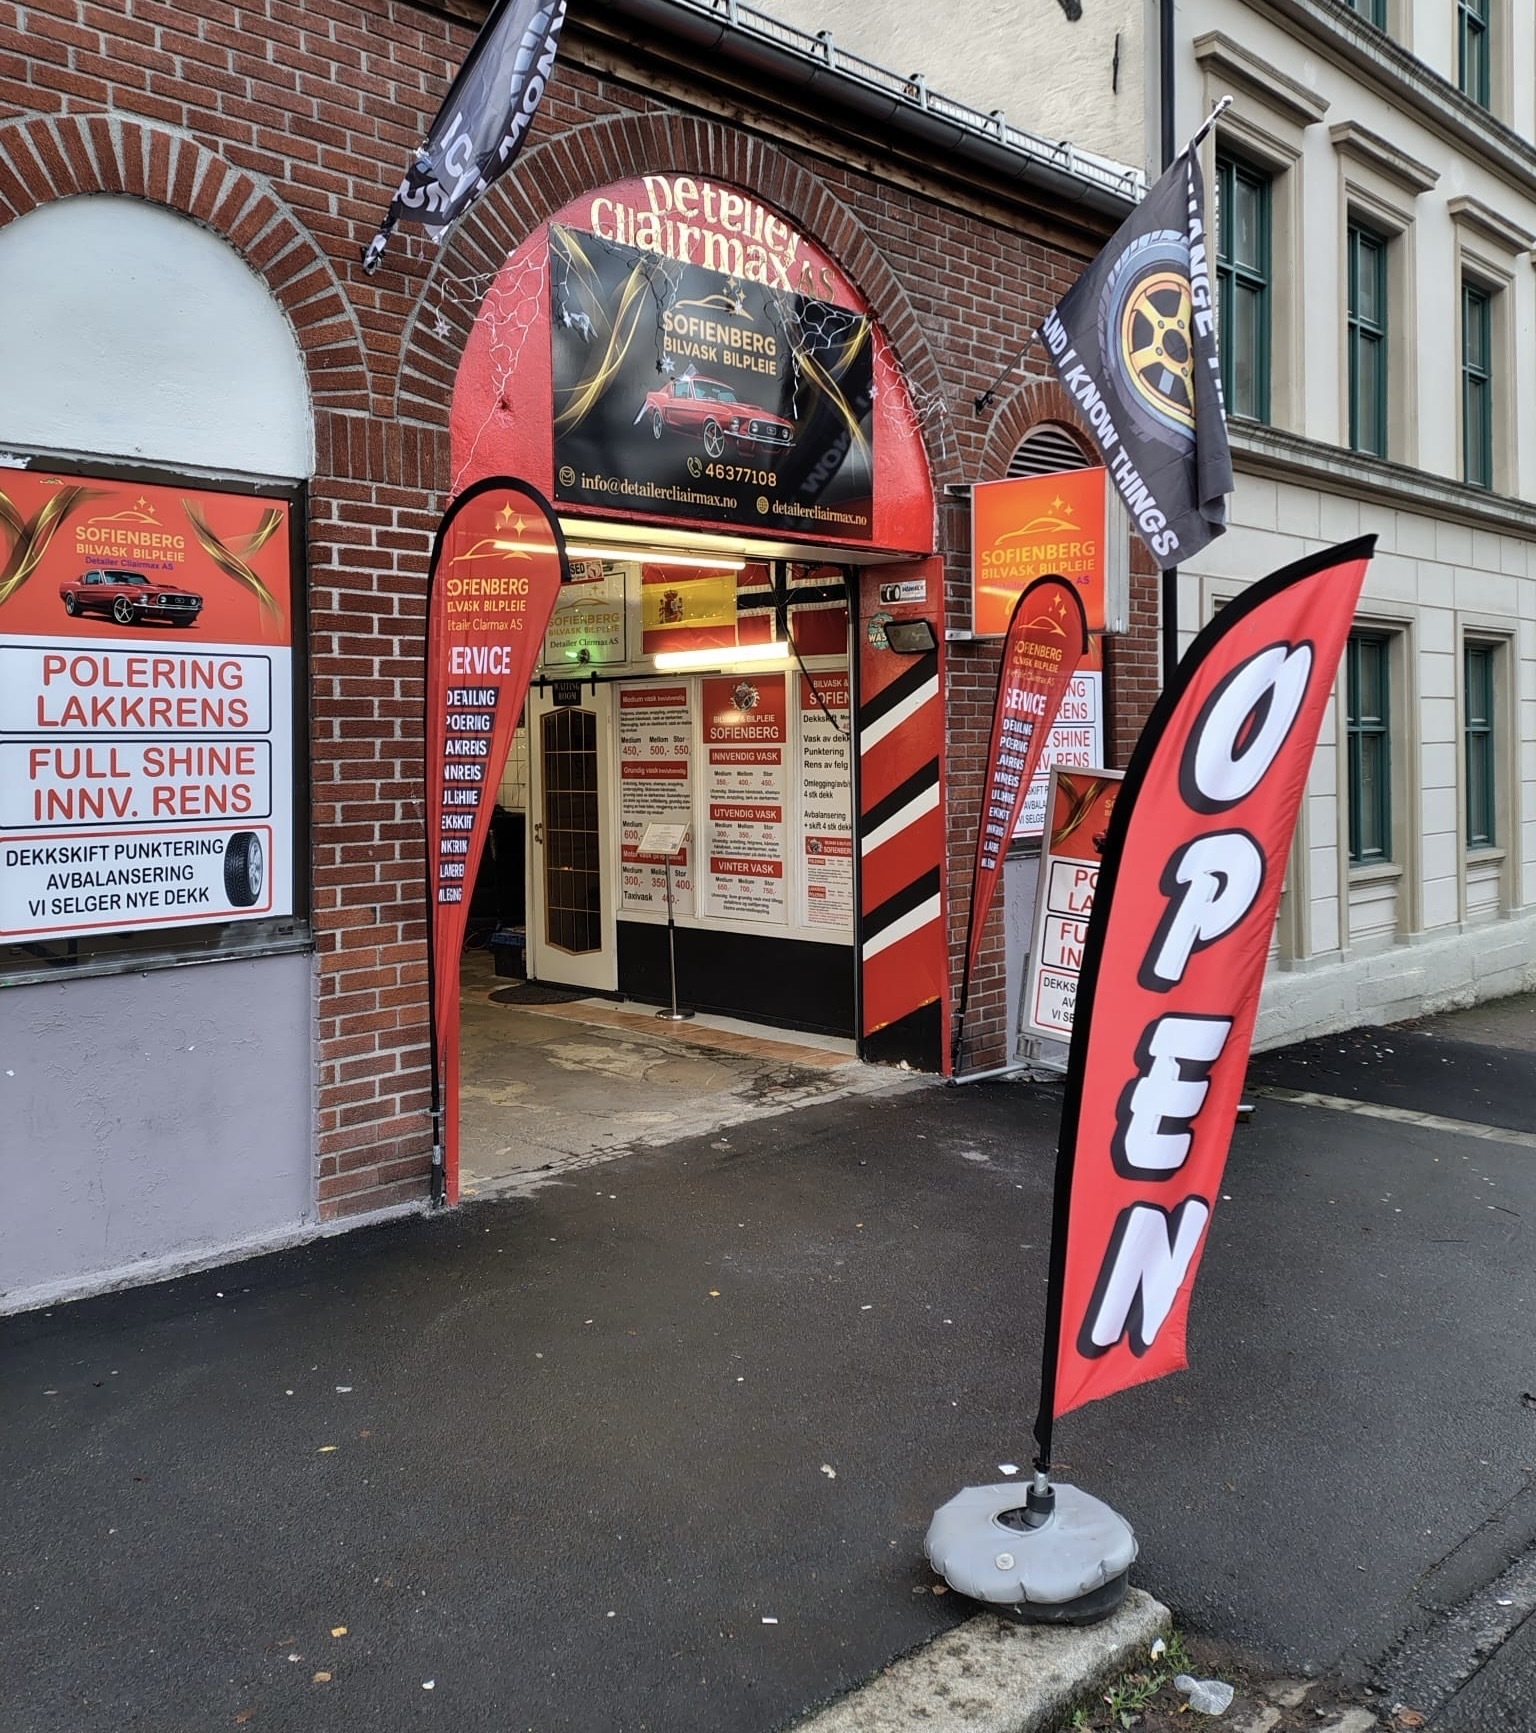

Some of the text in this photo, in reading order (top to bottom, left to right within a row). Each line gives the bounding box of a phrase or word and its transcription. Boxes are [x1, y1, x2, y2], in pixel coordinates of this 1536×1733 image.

[662, 311, 777, 356] SOFIENBERG
[663, 336, 777, 375] BILVASK BILPLEIE
[1058, 349, 1077, 368] I
[1064, 364, 1120, 450] KNOW
[705, 463, 777, 487] 46377108
[581, 472, 737, 509] info@detailercliairmax.no
[1111, 445, 1179, 556] THINGS
[772, 500, 867, 526] detailercliairmax.no
[76, 526, 185, 549] SOFIENBERG
[76, 543, 185, 562] BILVASK BILPLEIE
[981, 541, 1096, 566] SOFIENBERG
[161, 562, 174, 571] AS
[981, 559, 1095, 580] BILVASK BILPLEIE
[484, 600, 526, 612] BILPLEIE
[510, 618, 523, 631] AS
[550, 613, 620, 627] SOFIENBERG
[868, 633, 887, 642] WAS
[448, 646, 512, 675] ERVICE
[43, 655, 243, 690] POLERING
[813, 680, 842, 688] BILVASK
[37, 696, 249, 729] LAKKRENS
[746, 714, 775, 723] BILPLEIE
[673, 735, 685, 743] Stor
[710, 726, 779, 739] SOFIENBERG
[1053, 730, 1090, 748] SHINE
[623, 746, 642, 757] 450,-
[650, 745, 670, 757] 500,-
[712, 752, 778, 761] INNVENDIG VASK
[804, 748, 844, 757] Punktering
[29, 746, 256, 781] FULL SHINE
[804, 761, 822, 769] Rens
[834, 760, 848, 770] felg
[818, 791, 833, 799] dekk
[34, 784, 252, 821] INNV. RENS
[714, 809, 777, 819] UTVENDIG VASK
[804, 810, 846, 821] Avbalansering
[622, 820, 643, 828] Medium
[822, 822, 826, 830] 4
[827, 822, 837, 830] stk
[6, 839, 224, 868] DEKKSKIFT PUNKTERING
[622, 866, 643, 874] Medium
[718, 861, 774, 874] VINTER VASK
[46, 865, 194, 890] AVBALANSERING
[624, 876, 643, 887] 300,-
[28, 886, 210, 917] VI SELGER NYE DEKK
[624, 891, 653, 901] Taxivask
[1083, 643, 1313, 1353] OPEN
[1052, 1009, 1061, 1020] VI
